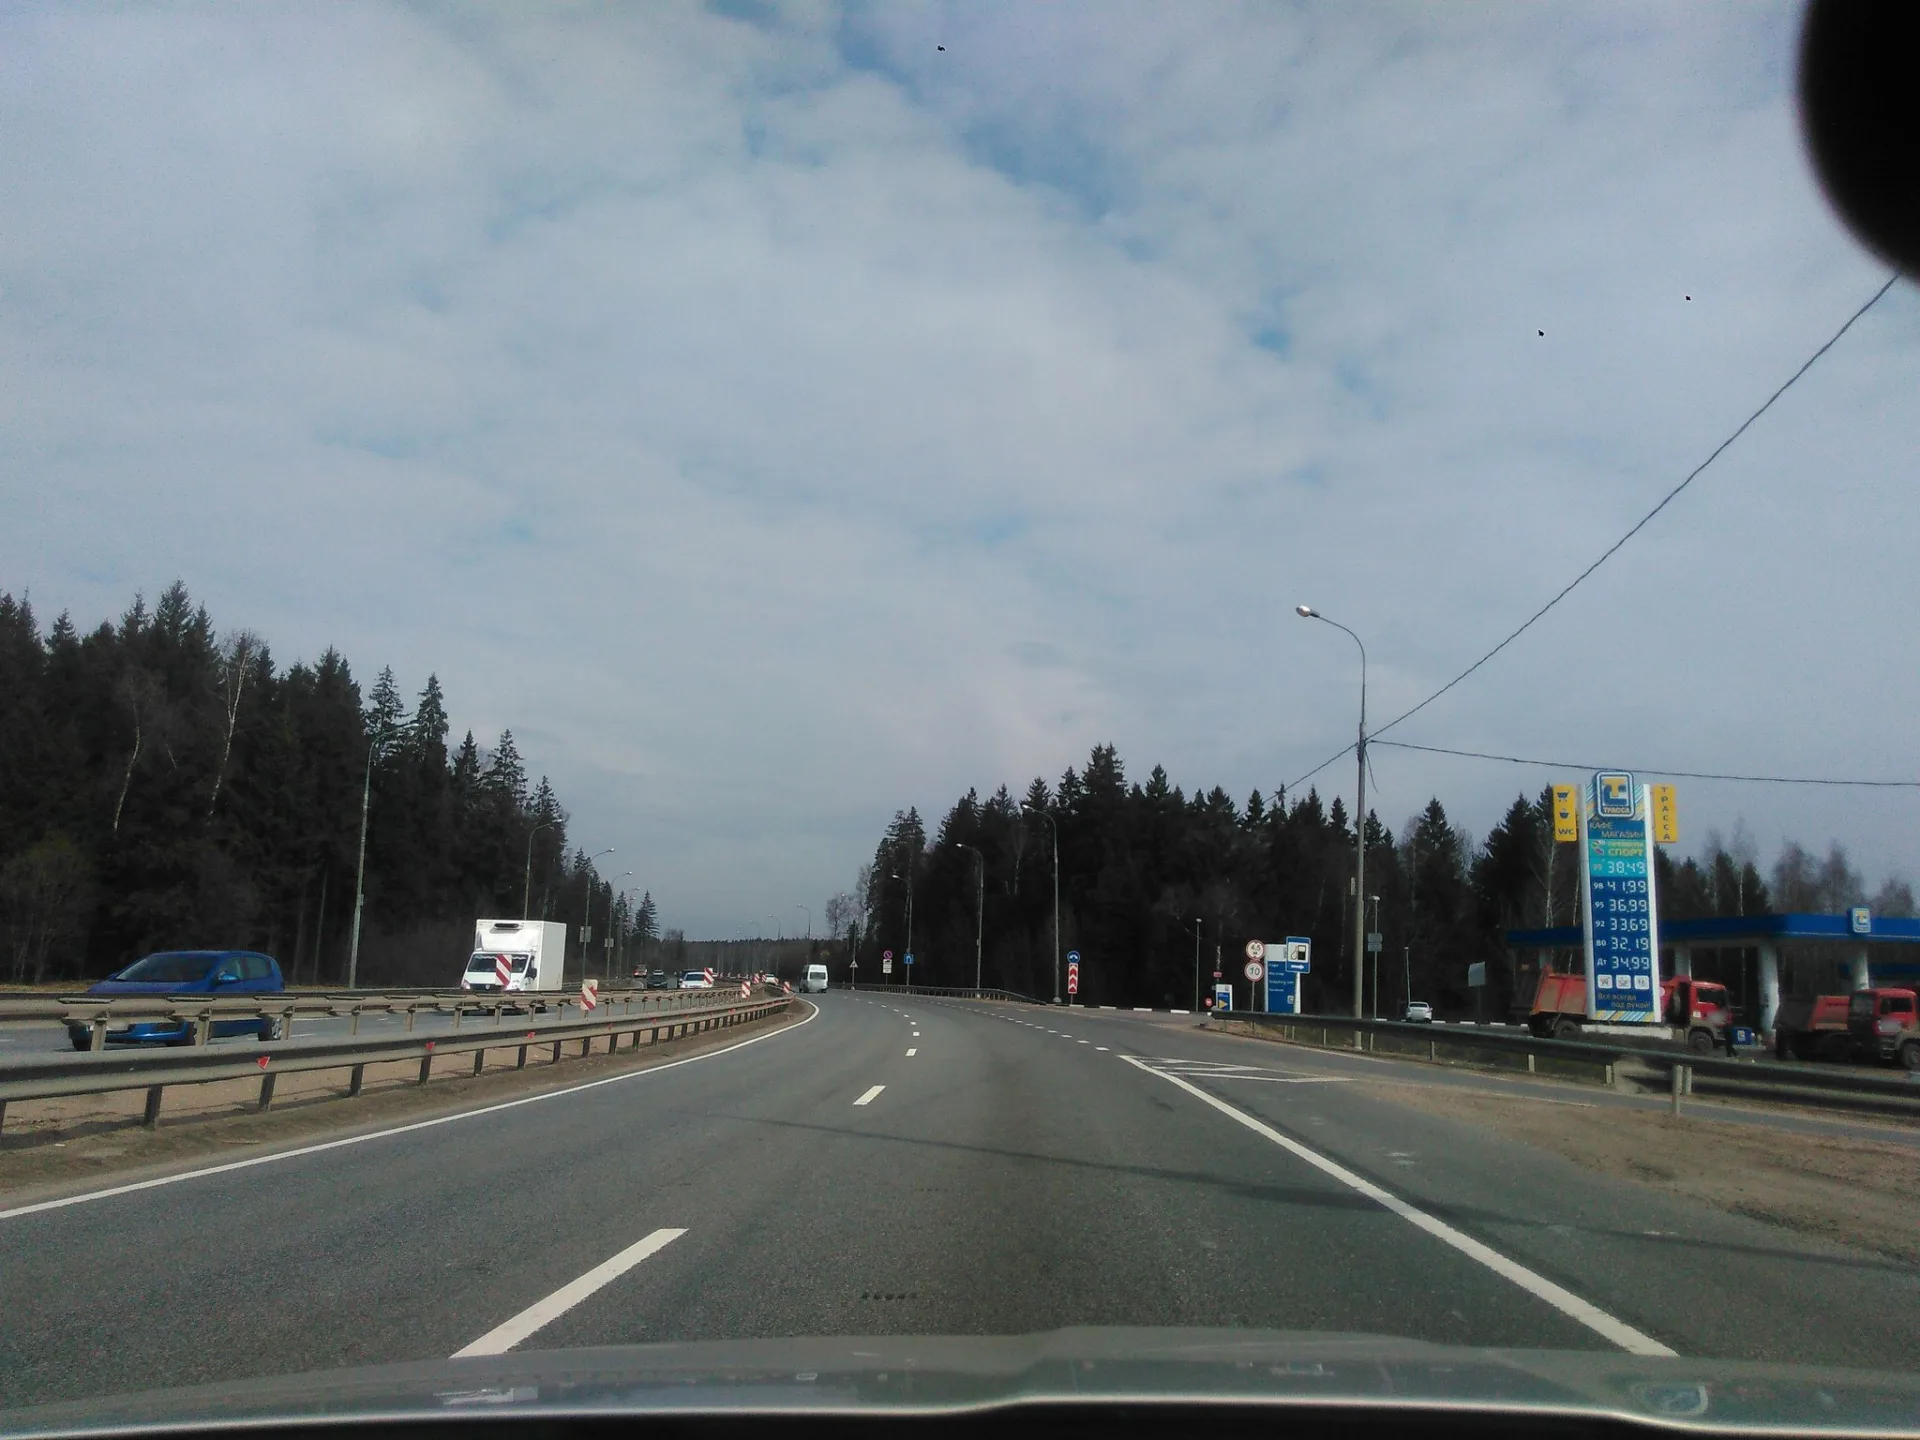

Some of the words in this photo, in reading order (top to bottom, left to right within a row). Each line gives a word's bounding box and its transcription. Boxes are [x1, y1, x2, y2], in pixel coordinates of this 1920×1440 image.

[1661, 787, 1671, 840] ТРАССА
[1590, 821, 1613, 829] КАФЕ
[1602, 831, 1645, 839] МАГАЗИН
[1593, 882, 1604, 890] 98
[1594, 901, 1604, 909] 95
[1595, 920, 1605, 928] 92
[1596, 939, 1606, 947] 80
[1250, 966, 1260, 976] 10
